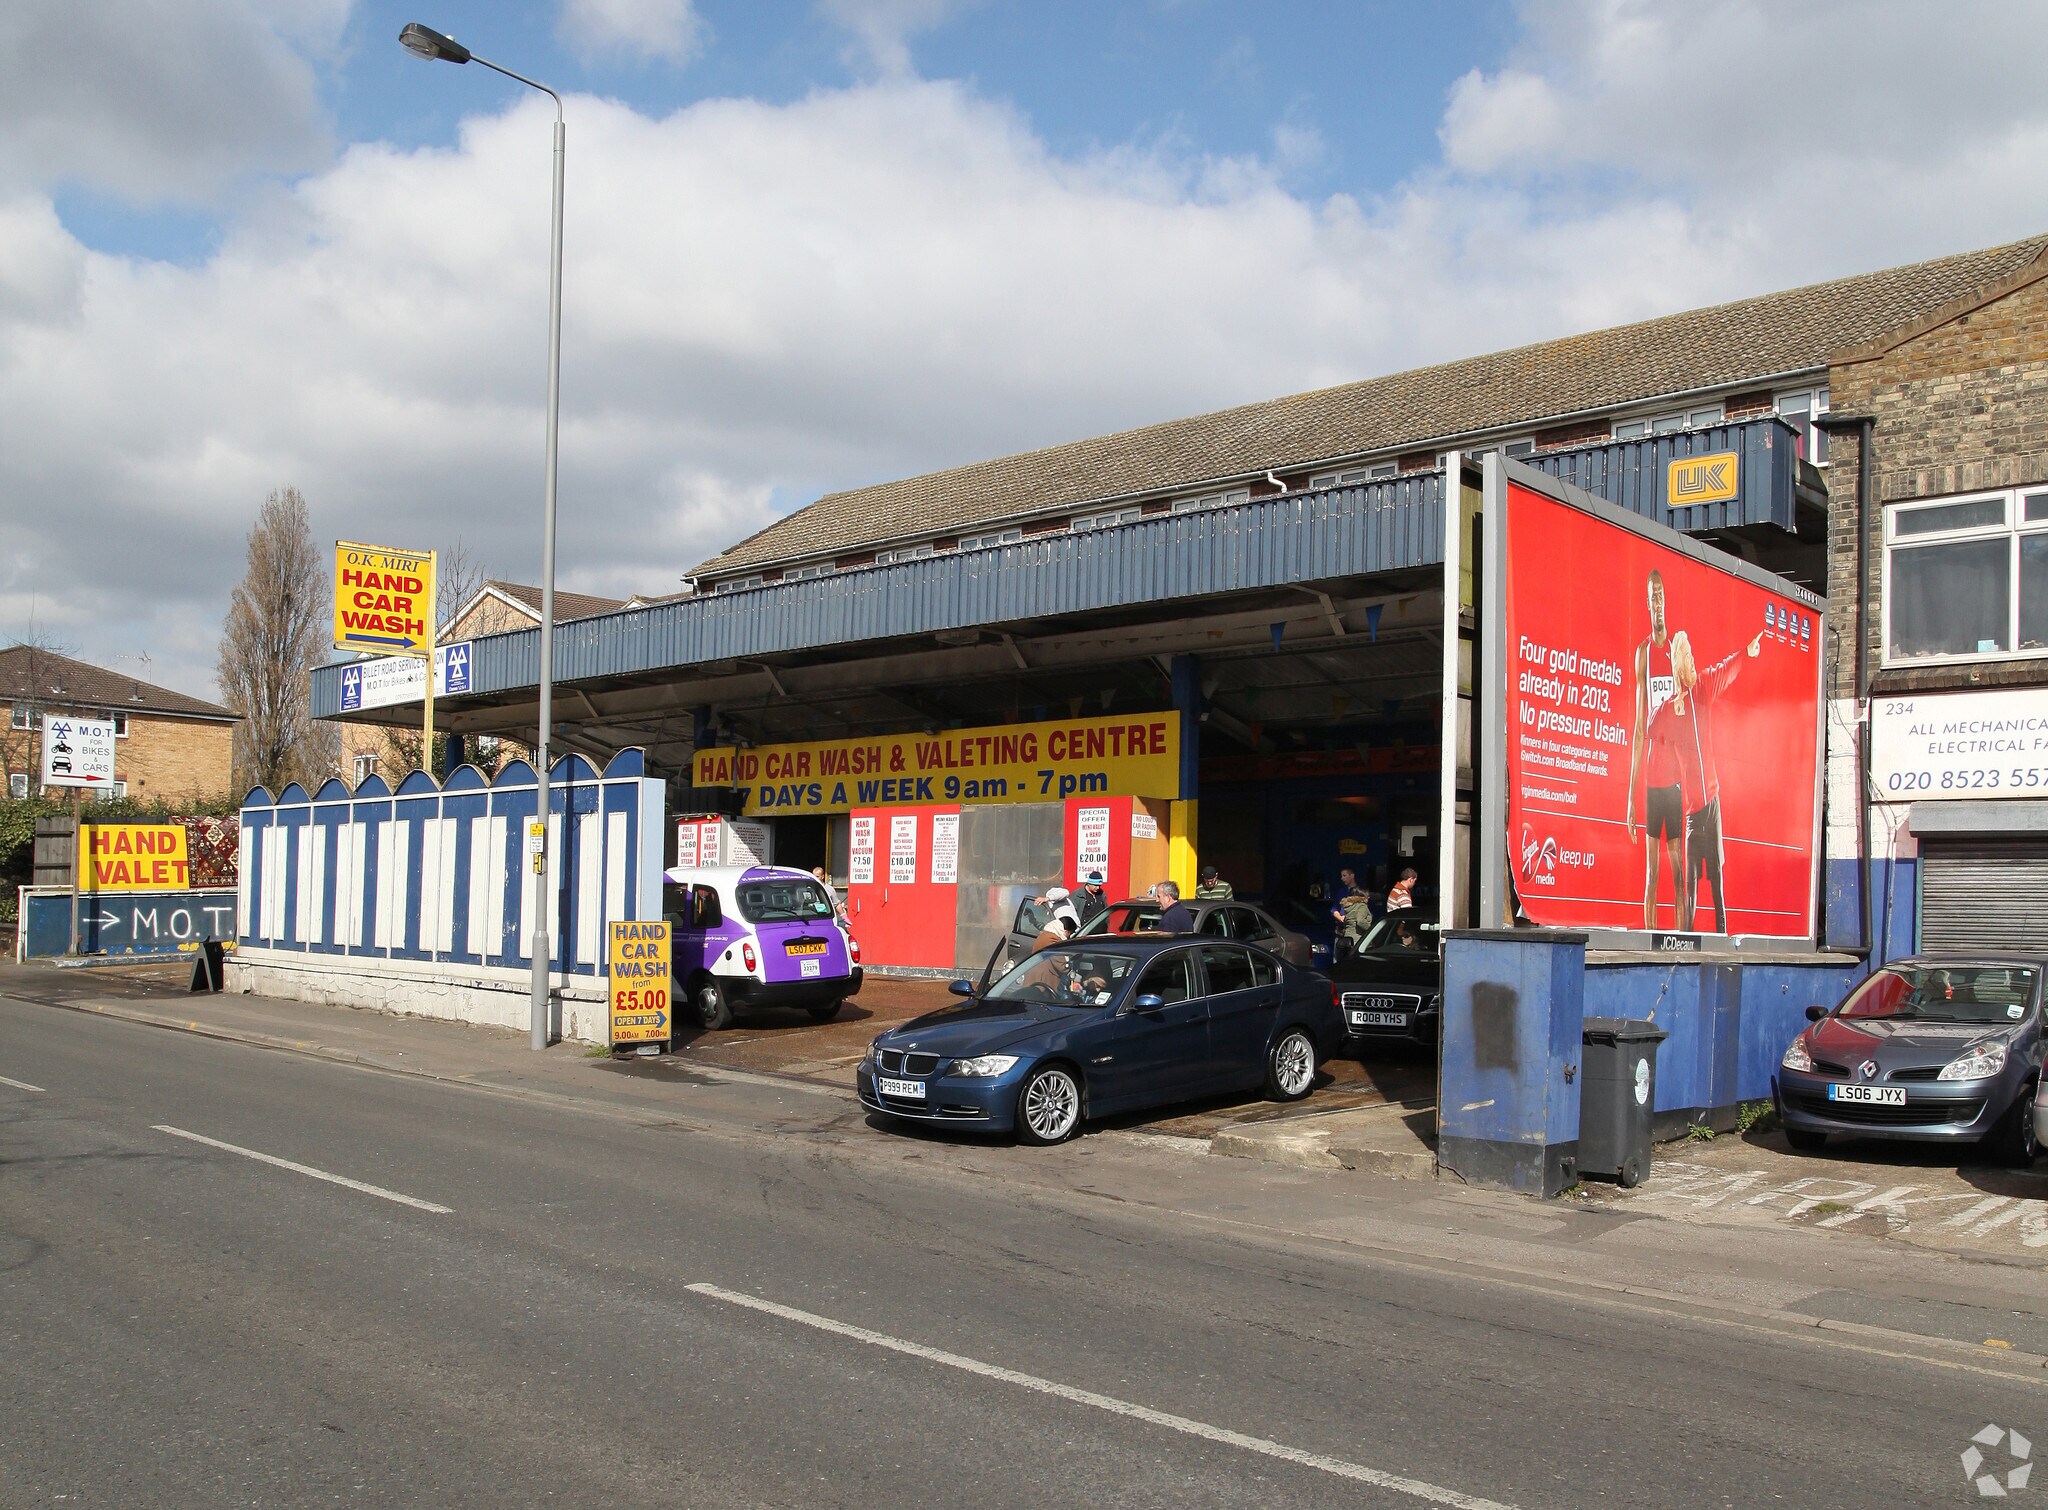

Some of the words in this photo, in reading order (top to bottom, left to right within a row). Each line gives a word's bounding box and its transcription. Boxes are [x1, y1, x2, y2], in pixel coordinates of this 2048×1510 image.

[1678, 462, 1728, 496] UK
[347, 552, 377, 567] O.K.
[380, 557, 419, 573] MIRI
[342, 569, 423, 594] HAND
[353, 592, 413, 614] CAR
[341, 611, 423, 636] WASH
[363, 664, 381, 679] BILLET
[382, 661, 397, 676] ROAD
[398, 657, 420, 673] SERVICE
[1520, 635, 1547, 665] Four
[1550, 648, 1578, 674] gold
[1579, 658, 1622, 686] medals
[391, 676, 406, 687] Bikes
[1653, 680, 1672, 692] BOLT
[1519, 669, 1565, 706] already
[1567, 680, 1579, 705] in
[1581, 684, 1611, 713] 2013.
[1886, 702, 1914, 716] 234
[1520, 700, 1535, 725] No
[1538, 710, 1591, 737] pressure
[1594, 718, 1628, 746] Usain.
[1909, 724, 1936, 736] ALL
[79, 726, 112, 738] M.O.T
[82, 746, 110, 756] BIKES
[701, 755, 759, 782] HAND
[765, 752, 811, 779] CAR
[820, 746, 881, 775] WASH
[890, 744, 906, 772] &
[916, 732, 1037, 770] VALETING
[1048, 722, 1166, 761] CENTRE
[1542, 739, 1548, 750] in
[1549, 740, 1561, 752] four
[1562, 744, 1592, 759] categories
[1592, 750, 1598, 760] at
[1599, 750, 1609, 762] the
[1928, 739, 2026, 754] ELECTRICAL
[82, 763, 109, 772] CARS
[1556, 756, 1587, 772] Broadband
[1888, 772, 1932, 790] 020
[1941, 769, 2000, 790] 8523
[742, 788, 751, 807] 7
[760, 783, 822, 807] DAYS
[831, 782, 848, 804] A
[858, 777, 934, 803] WEEK
[944, 776, 1008, 799] 9am
[1037, 770, 1108, 799] 7pm
[856, 820, 869, 828] HAND
[90, 831, 177, 855] HAND
[854, 857, 871, 865] £7.50
[892, 857, 915, 866] £10.00
[1080, 854, 1107, 862] £20.00
[1560, 846, 1581, 869] keep
[1584, 852, 1595, 870] up
[94, 860, 189, 884] VALET
[1536, 873, 1555, 885] media
[133, 906, 233, 940] M.O.T.
[615, 924, 666, 940] HAND
[622, 943, 659, 959] CAR
[789, 944, 807, 954] LS07
[809, 944, 824, 953] CKK
[1660, 936, 1695, 951] JCDecaux
[614, 962, 667, 978] WASH
[632, 980, 650, 989] from
[616, 990, 666, 1011] £5.00
[617, 1016, 636, 1026] OPEN
[638, 1016, 642, 1025] 7
[643, 1015, 661, 1025] DAYS
[1356, 1013, 1380, 1022] RO08
[1384, 1014, 1402, 1024] YHS
[884, 1080, 900, 1093] P999
[902, 1084, 918, 1095] REM
[1838, 1086, 1872, 1100] LS06
[1876, 1089, 1903, 1103] JYX
